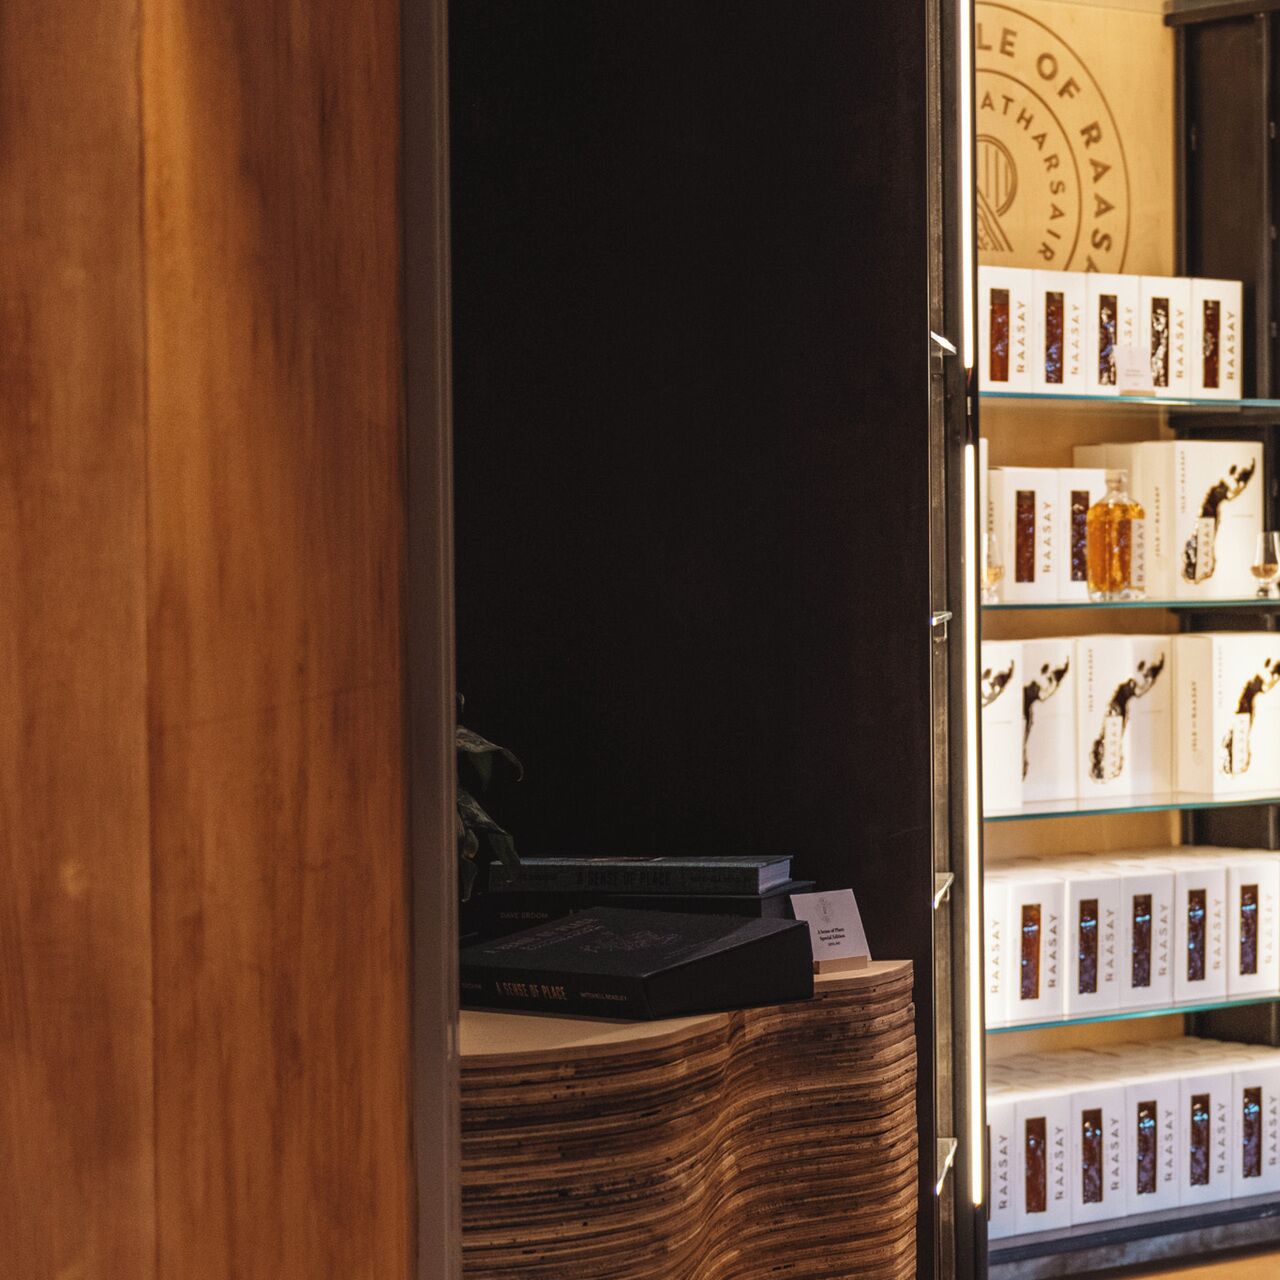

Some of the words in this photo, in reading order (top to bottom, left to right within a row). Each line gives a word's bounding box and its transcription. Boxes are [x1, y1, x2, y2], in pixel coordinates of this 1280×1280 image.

[1036, 52, 1081, 99] OF
[981, 91, 1066, 262] ATHARSAIR
[1017, 301, 1026, 373] RAASAY
[1071, 305, 1080, 375] RAASAY
[1125, 307, 1133, 342] SAY
[1176, 309, 1184, 379] RAASAY
[1227, 311, 1235, 380] RAASAY
[1043, 501, 1051, 573] RAASAY
[992, 918, 1001, 993] RAASAY
[1048, 914, 1058, 988] RAASAY
[1105, 909, 1114, 982] RAASAY
[1159, 904, 1168, 976] RAASAY
[1213, 898, 1222, 970] RAASAY
[1055, 1127, 1064, 1200] RAASAY
[1111, 1117, 1119, 1191] RAASAY
[1165, 1110, 1173, 1181] RAASAY
[1217, 1102, 1226, 1174] RAASAY
[1269, 1095, 1278, 1166] RAASAY
[998, 1134, 1008, 1209] RAASAY
